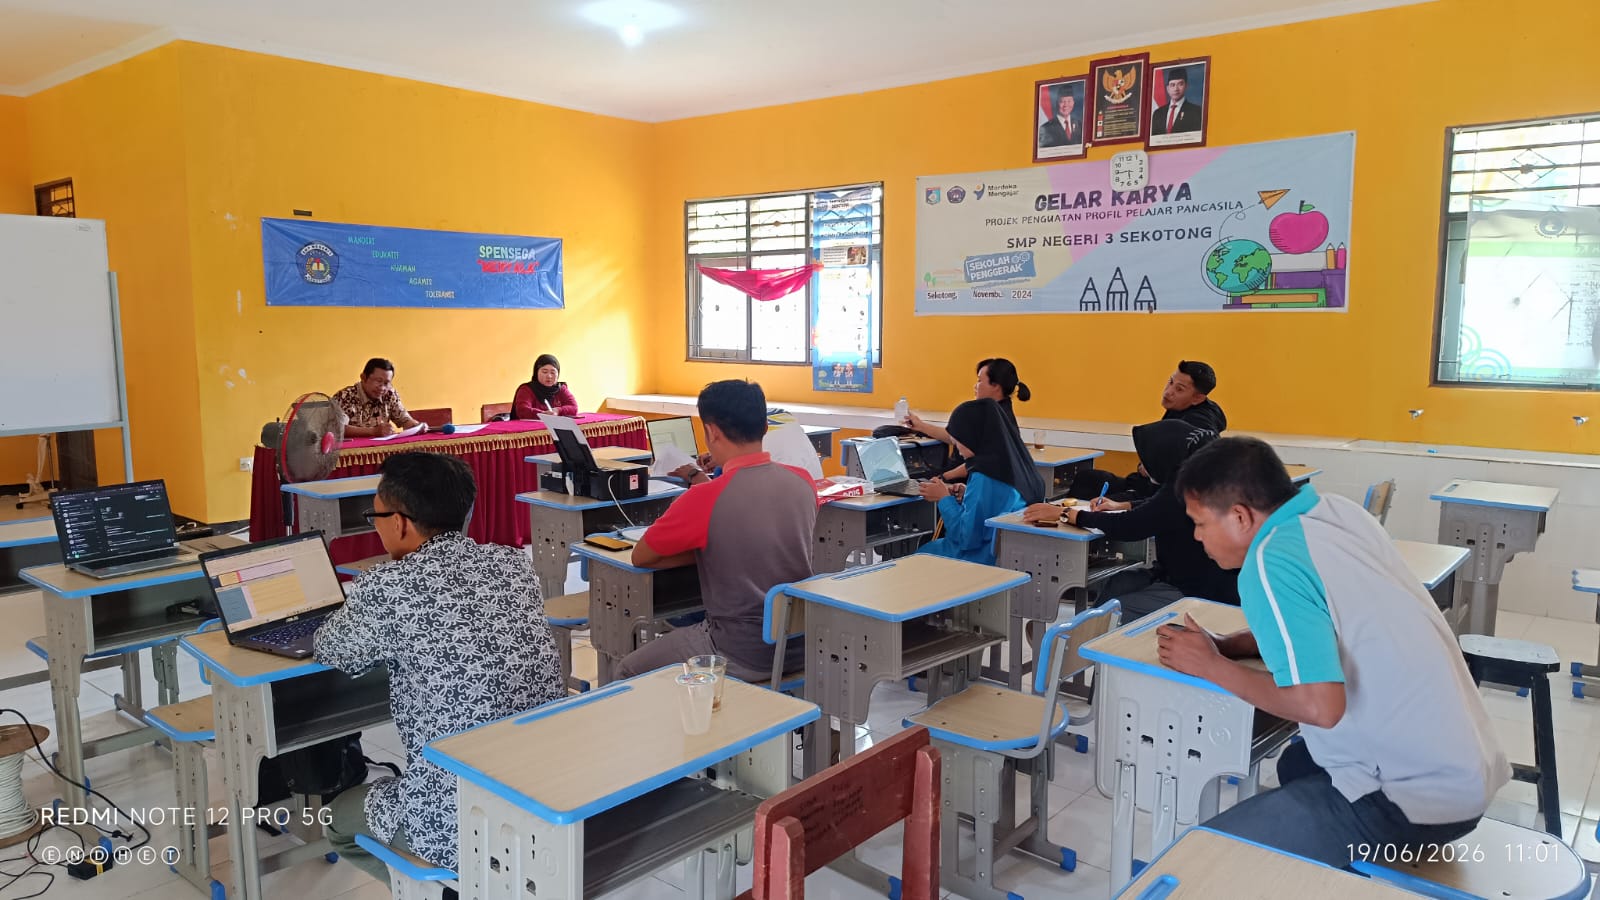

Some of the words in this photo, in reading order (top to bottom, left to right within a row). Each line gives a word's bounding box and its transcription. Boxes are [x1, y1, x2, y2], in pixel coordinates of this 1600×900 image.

[987, 183, 1017, 191] Merdeka
[1034, 190, 1102, 212] GELAR
[1111, 182, 1192, 207] KARYA
[985, 217, 1018, 227] PROJEK
[1021, 213, 1082, 225] PENGUATAN
[1085, 209, 1122, 220] PROFIL
[1126, 206, 1173, 218] PELAJAR
[1176, 200, 1244, 214] PANCASILA
[1006, 236, 1037, 249] SMP
[1042, 233, 1099, 247] NEGERI
[1105, 232, 1114, 244] 3
[1119, 226, 1213, 243] SEKOTONG
[479, 245, 536, 260] SPENSEGA
[969, 256, 1010, 271] SEKOLAH
[970, 264, 1023, 281] PENGGERAK
[408, 277, 433, 286] AGAMIS
[1012, 290, 1032, 299] 2024
